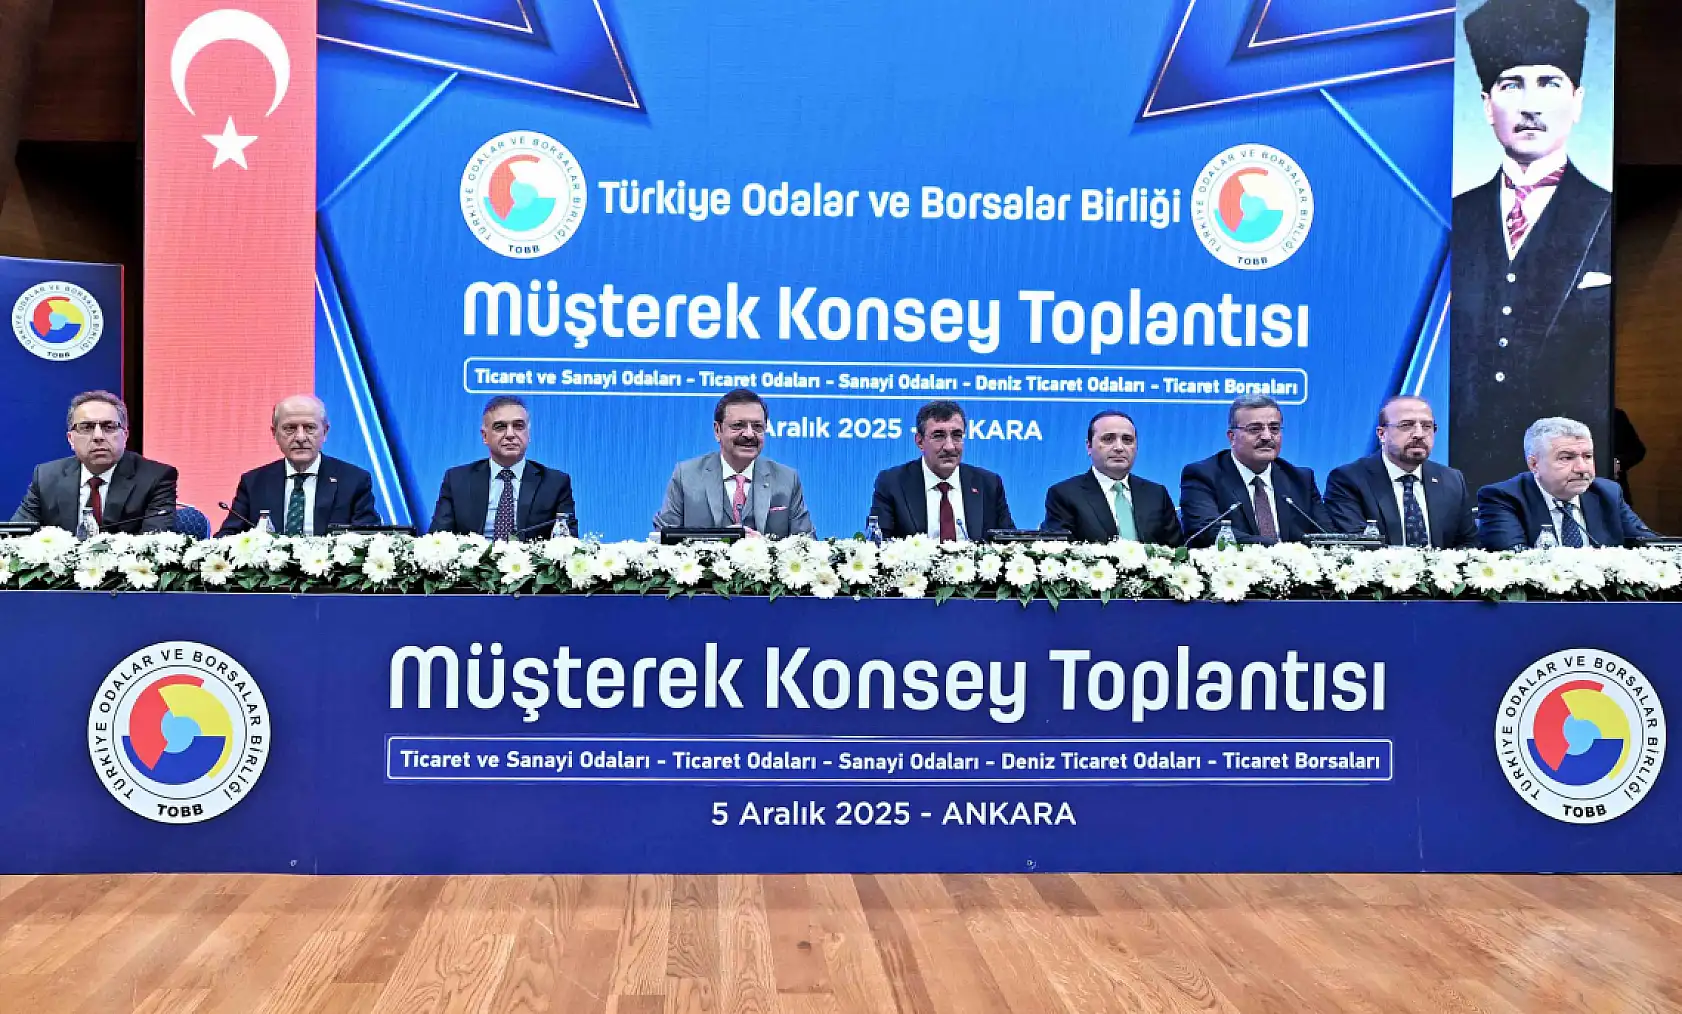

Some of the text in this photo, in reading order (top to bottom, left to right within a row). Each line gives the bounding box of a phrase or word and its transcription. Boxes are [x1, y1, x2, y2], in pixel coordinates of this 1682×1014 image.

[510, 136, 525, 145] VE
[1240, 149, 1256, 158] VE
[598, 180, 1181, 229] Türkiye Odalar ve Borsalar Birliği
[508, 244, 540, 254] TOBB
[1237, 256, 1269, 265] TOBB
[463, 279, 1309, 355] Müşterek Konsey Toplantısı
[474, 367, 533, 384] Ticaret
[537, 373, 557, 385] ve
[561, 369, 617, 389] Sanayi
[622, 369, 682, 387] Odaları
[699, 371, 757, 388] Ticaret
[761, 371, 820, 388] Odaları
[838, 373, 894, 393] Sanayi
[898, 373, 957, 391] Odaları
[975, 374, 1022, 391] Deniz
[1026, 375, 1083, 392] Ticaret
[1088, 376, 1145, 393] Odaları
[1163, 377, 1220, 394] Ticaret
[1224, 378, 1298, 395] Borsaları
[837, 417, 902, 439] 2025
[389, 641, 1385, 724] Müşterek Konsey Toplantısı
[94, 648, 265, 801] TÜRKİYE ODALAR VE BORSALAR BİRLİĞİ
[1501, 655, 1660, 801] TÜRKİYE ODALAR VE BORSALAR BİRLİĞİ
[400, 750, 471, 768] Ticaret
[476, 754, 500, 768] ve
[506, 750, 573, 773] Sanayi
[580, 750, 650, 769] Odaları
[672, 751, 741, 769] Ticaret
[747, 751, 817, 770] Odaları
[838, 751, 904, 774] Sanayi
[910, 751, 979, 770] Odaları
[1001, 751, 1055, 770] Deniz
[1060, 751, 1127, 770] Ticaret
[1133, 751, 1201, 770] Odaları
[1222, 751, 1289, 770] Ticaret
[1295, 751, 1380, 770] Borsaları
[157, 803, 204, 818] TOBB
[711, 802, 728, 826] 5
[738, 800, 826, 826] Aralık
[835, 802, 910, 826] 2025
[942, 802, 1077, 825] ANKARA
[1562, 804, 1608, 818] TOBB
